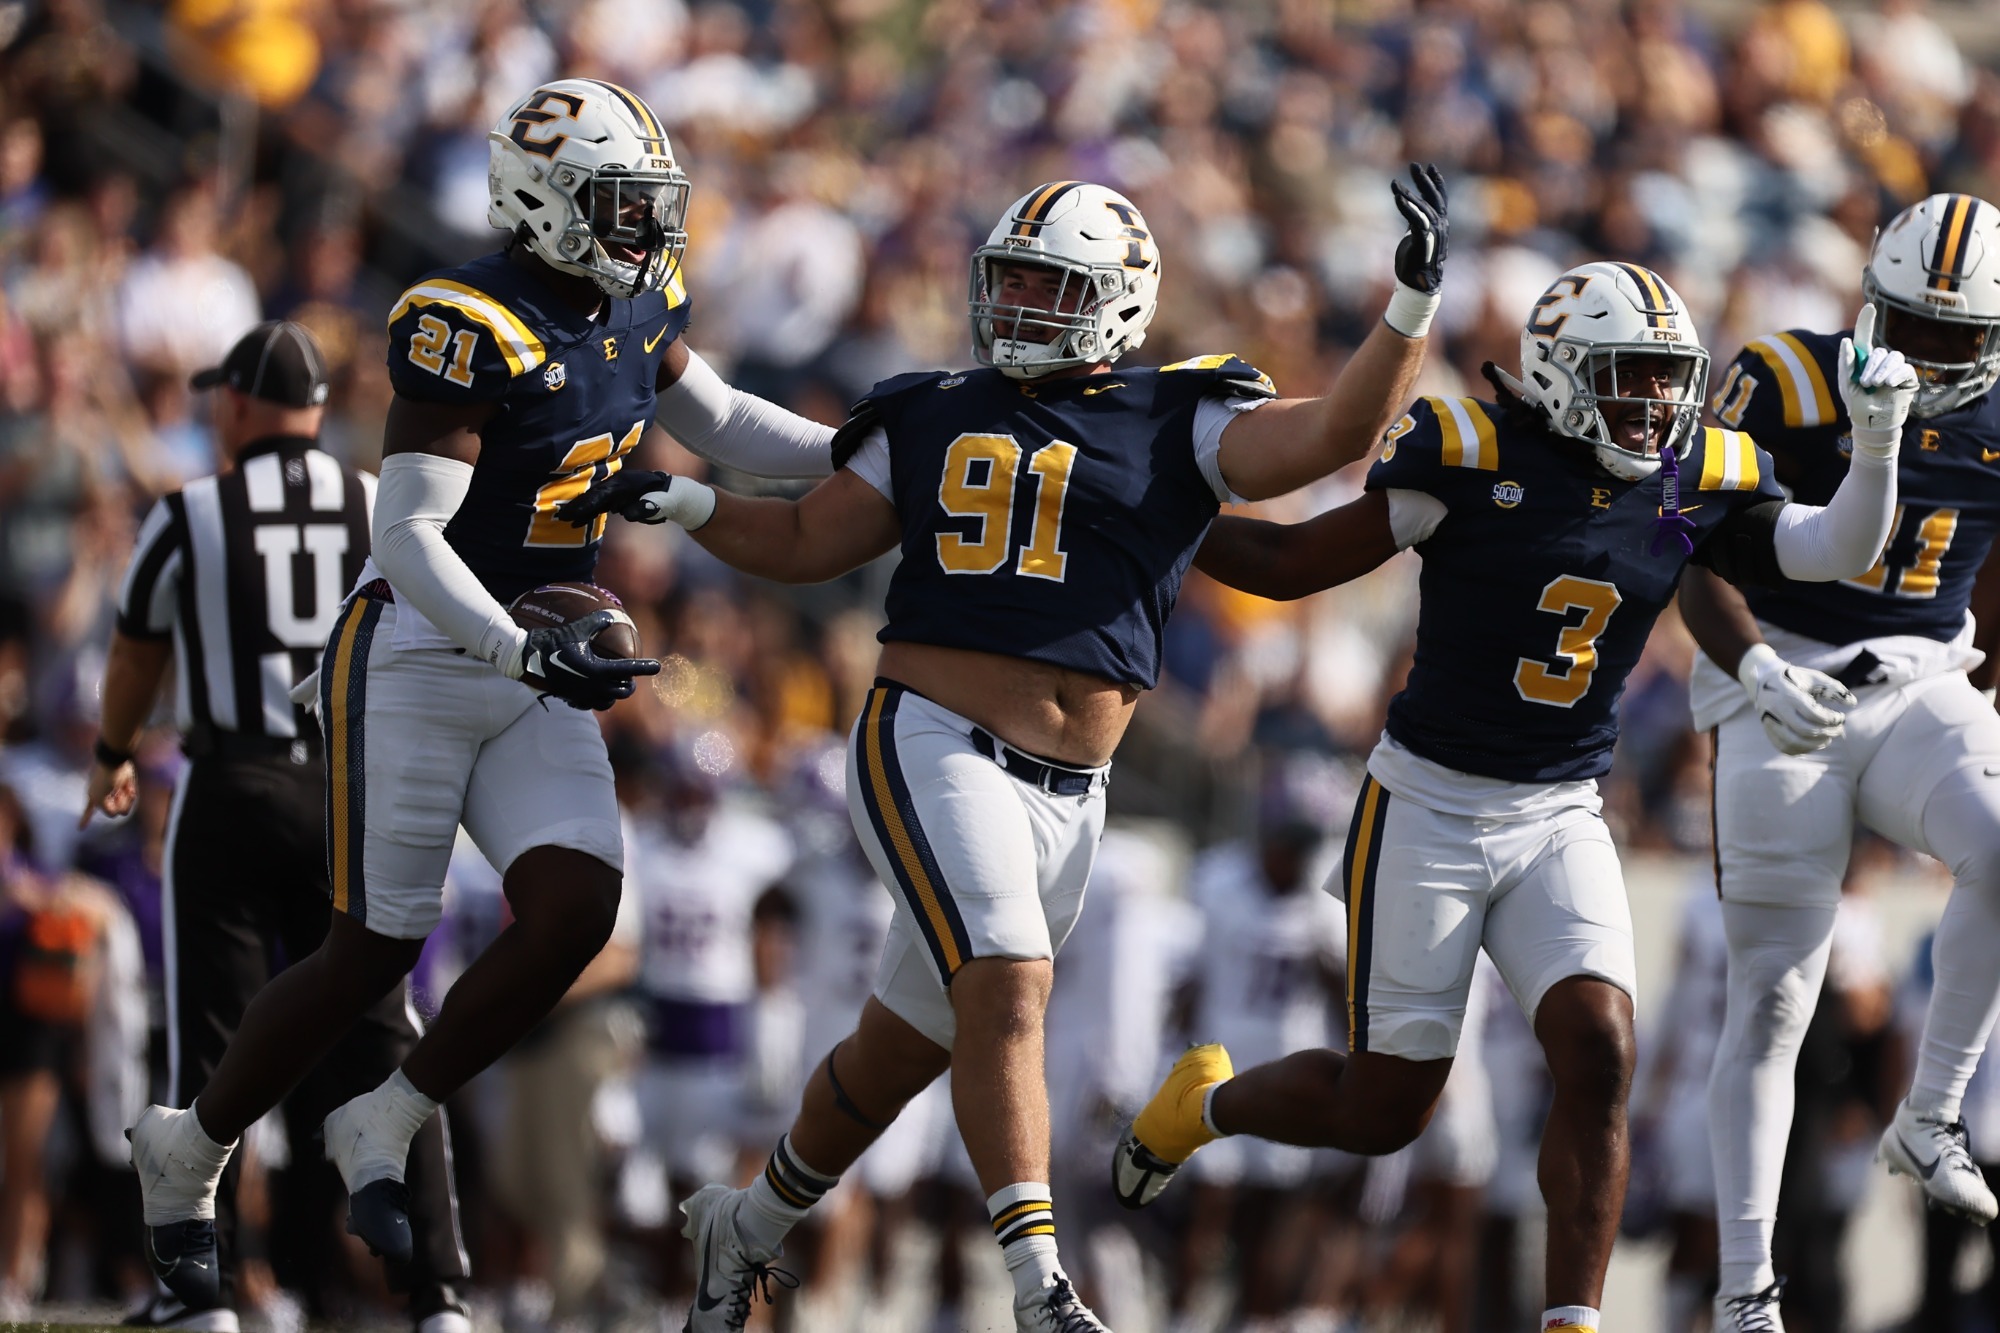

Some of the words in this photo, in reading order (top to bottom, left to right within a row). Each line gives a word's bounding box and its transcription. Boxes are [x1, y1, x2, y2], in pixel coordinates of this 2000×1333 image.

[650, 158, 673, 169] ETSU
[1003, 237, 1032, 248] ETSU
[407, 313, 479, 389] 21
[602, 337, 618, 362] E
[1653, 330, 1682, 342] ETSU
[1712, 362, 1759, 430] 11
[934, 432, 1079, 583] 91
[1492, 484, 1525, 503] SOCON
[1590, 487, 1612, 510] E
[1663, 476, 1677, 511] NXTRND
[254, 523, 350, 648] U
[1512, 573, 1623, 708] 3
